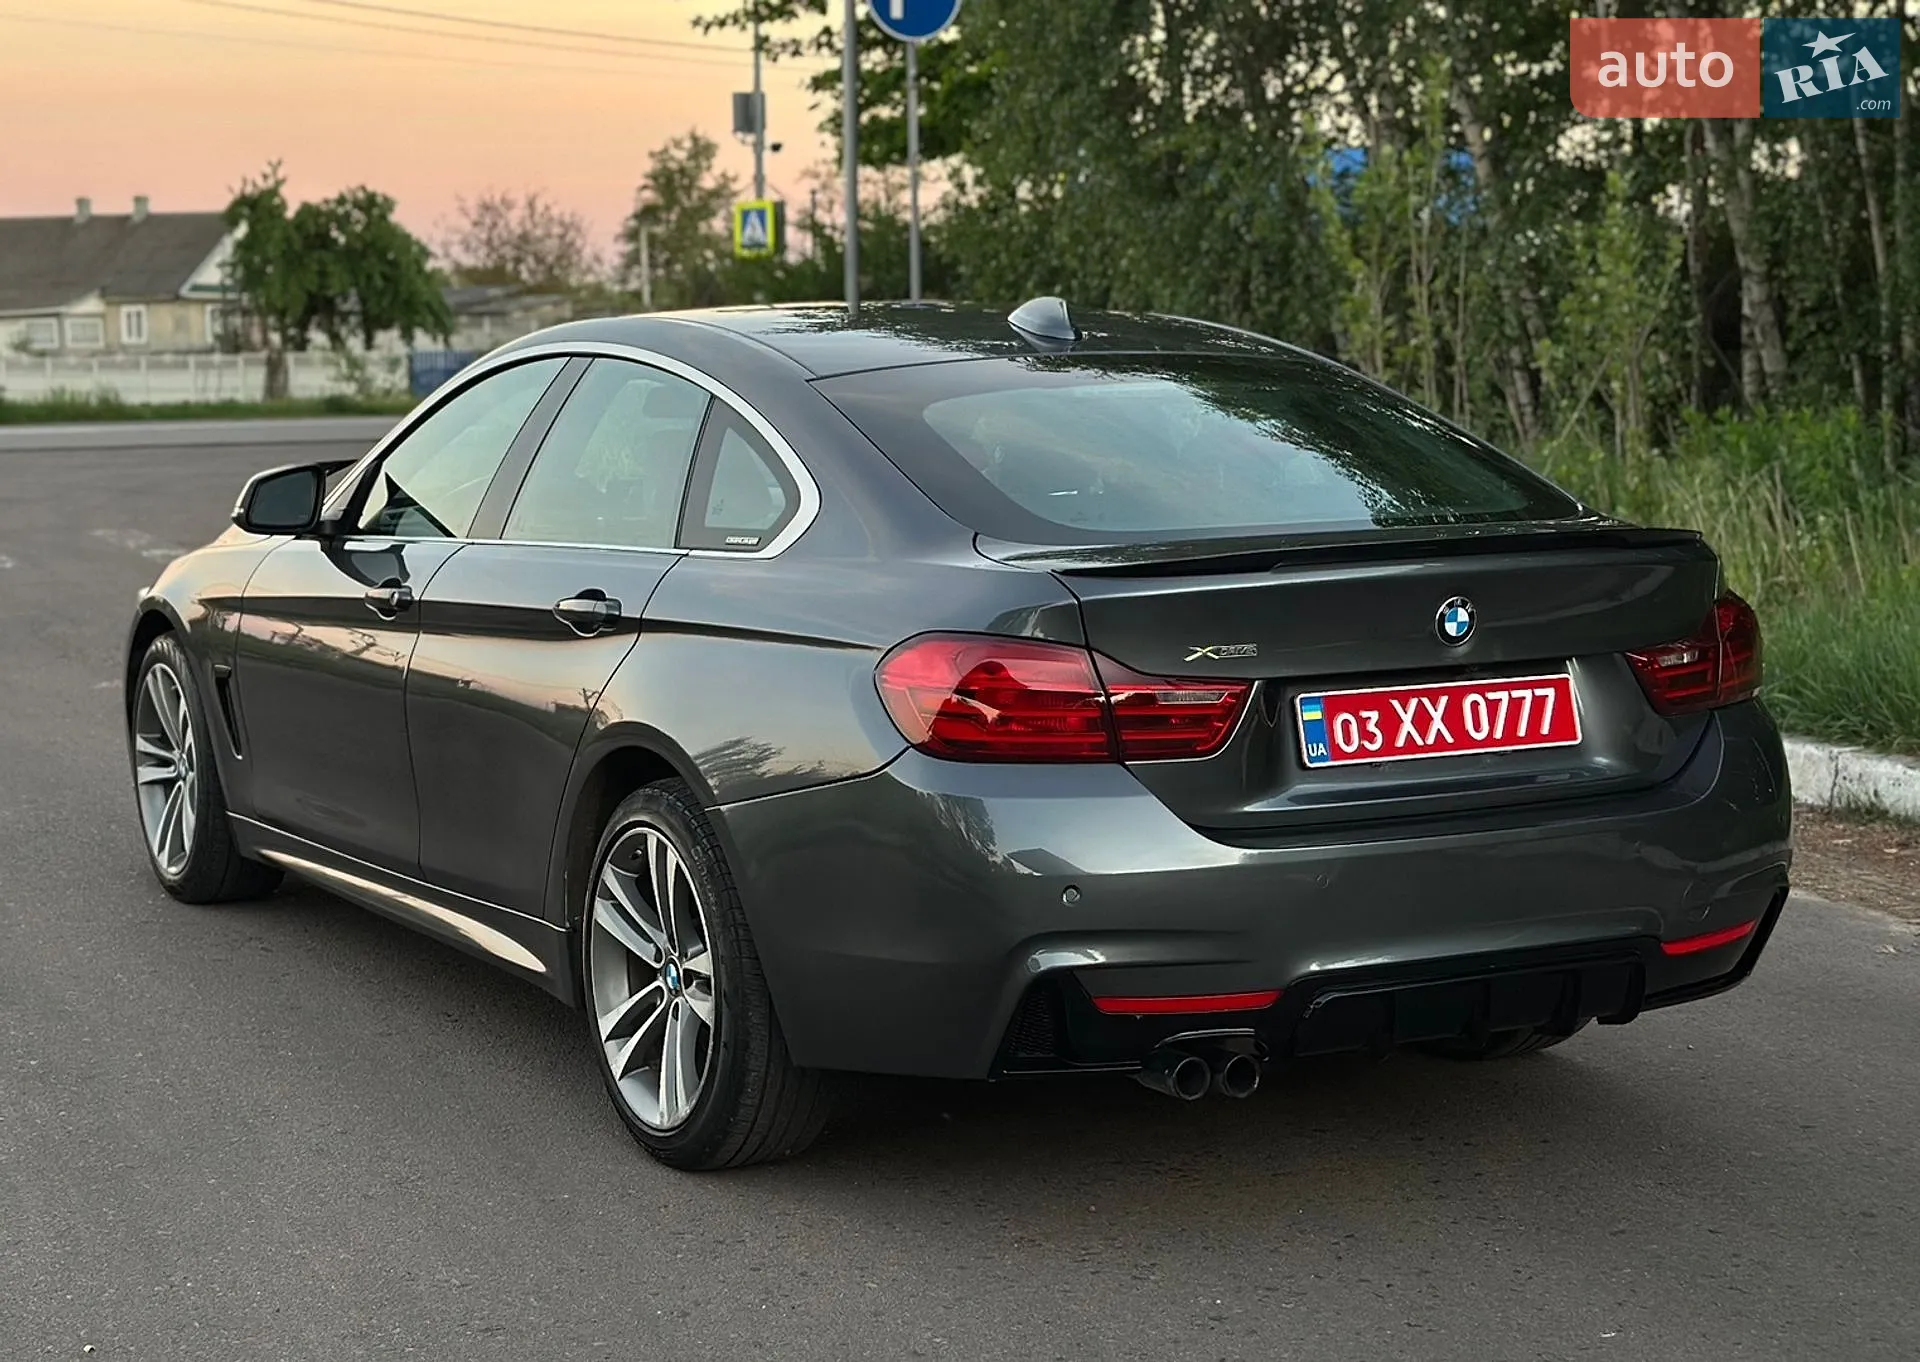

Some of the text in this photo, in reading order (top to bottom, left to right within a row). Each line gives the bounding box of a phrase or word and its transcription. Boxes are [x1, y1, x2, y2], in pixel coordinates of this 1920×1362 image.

[1333, 687, 1556, 753] 03 XX 0777
[1308, 742, 1328, 757] UA
